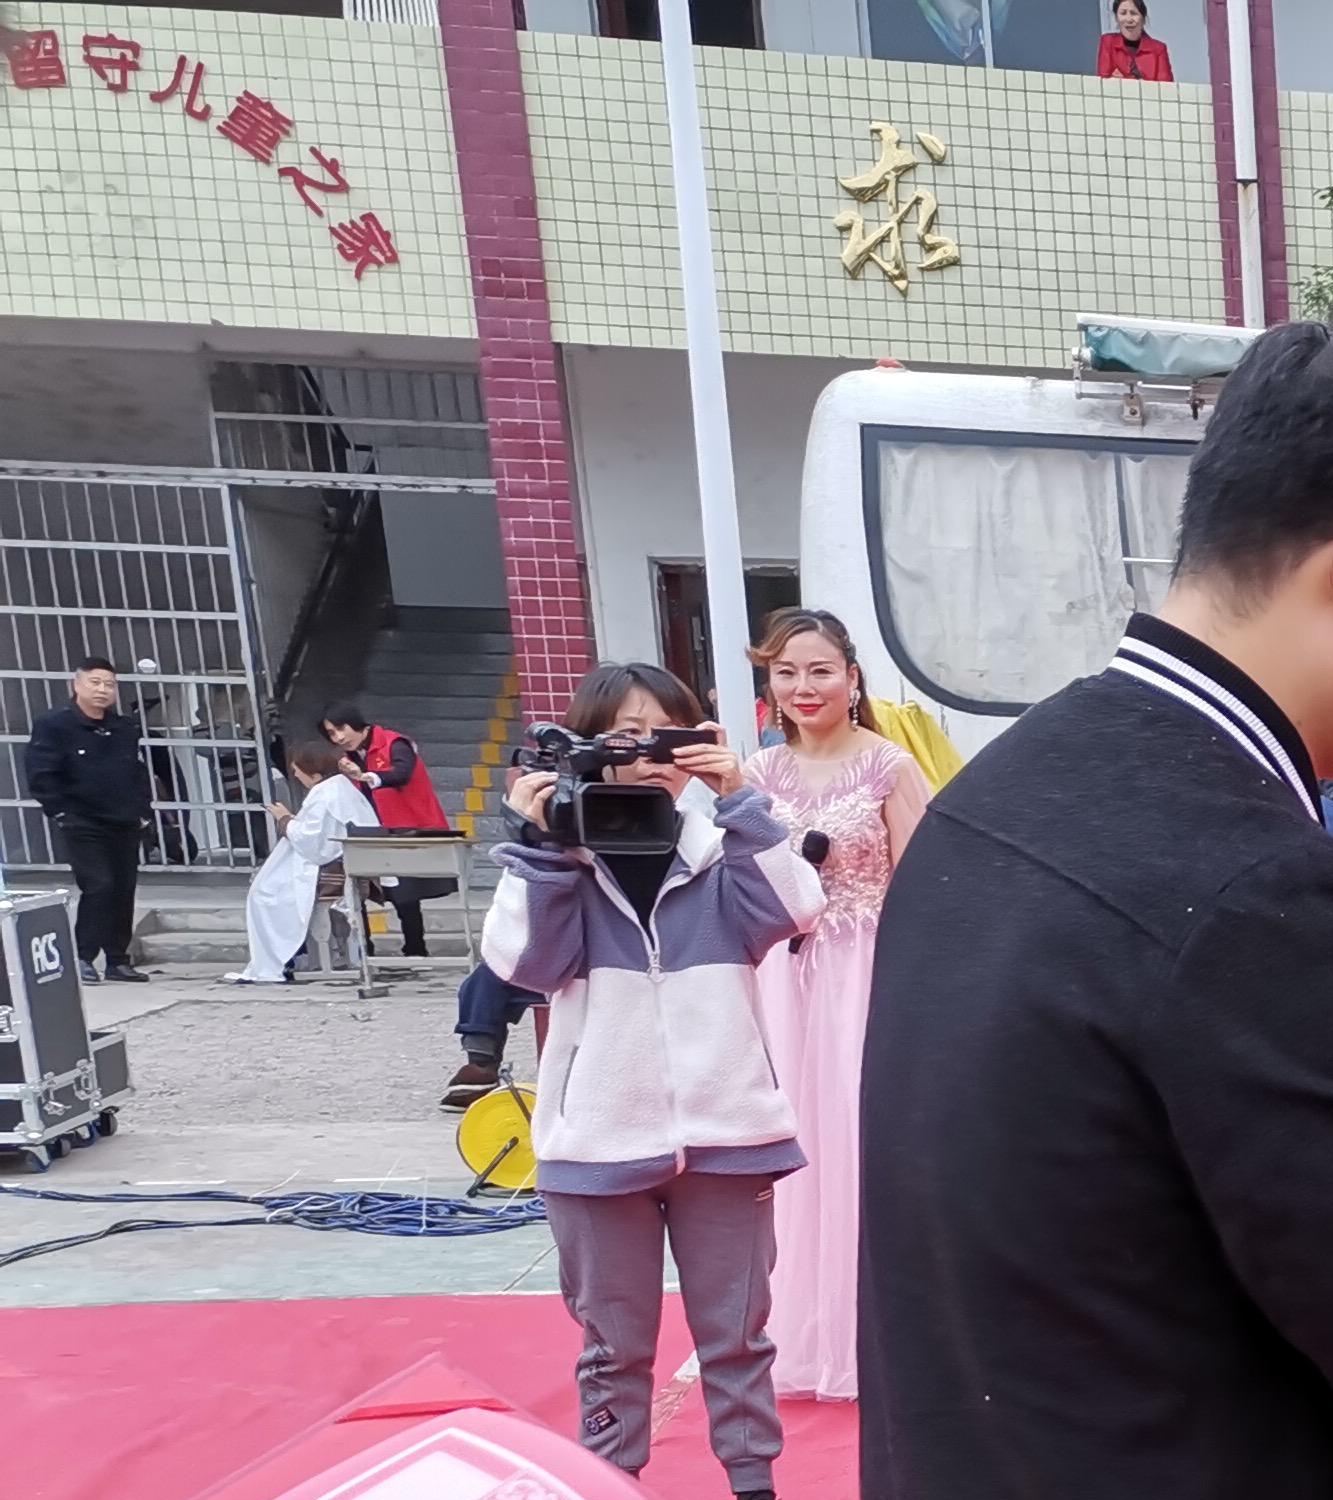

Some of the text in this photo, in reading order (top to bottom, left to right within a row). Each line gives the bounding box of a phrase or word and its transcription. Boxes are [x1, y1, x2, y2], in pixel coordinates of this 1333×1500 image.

[2, 30, 399, 280] 留守儿童之家
